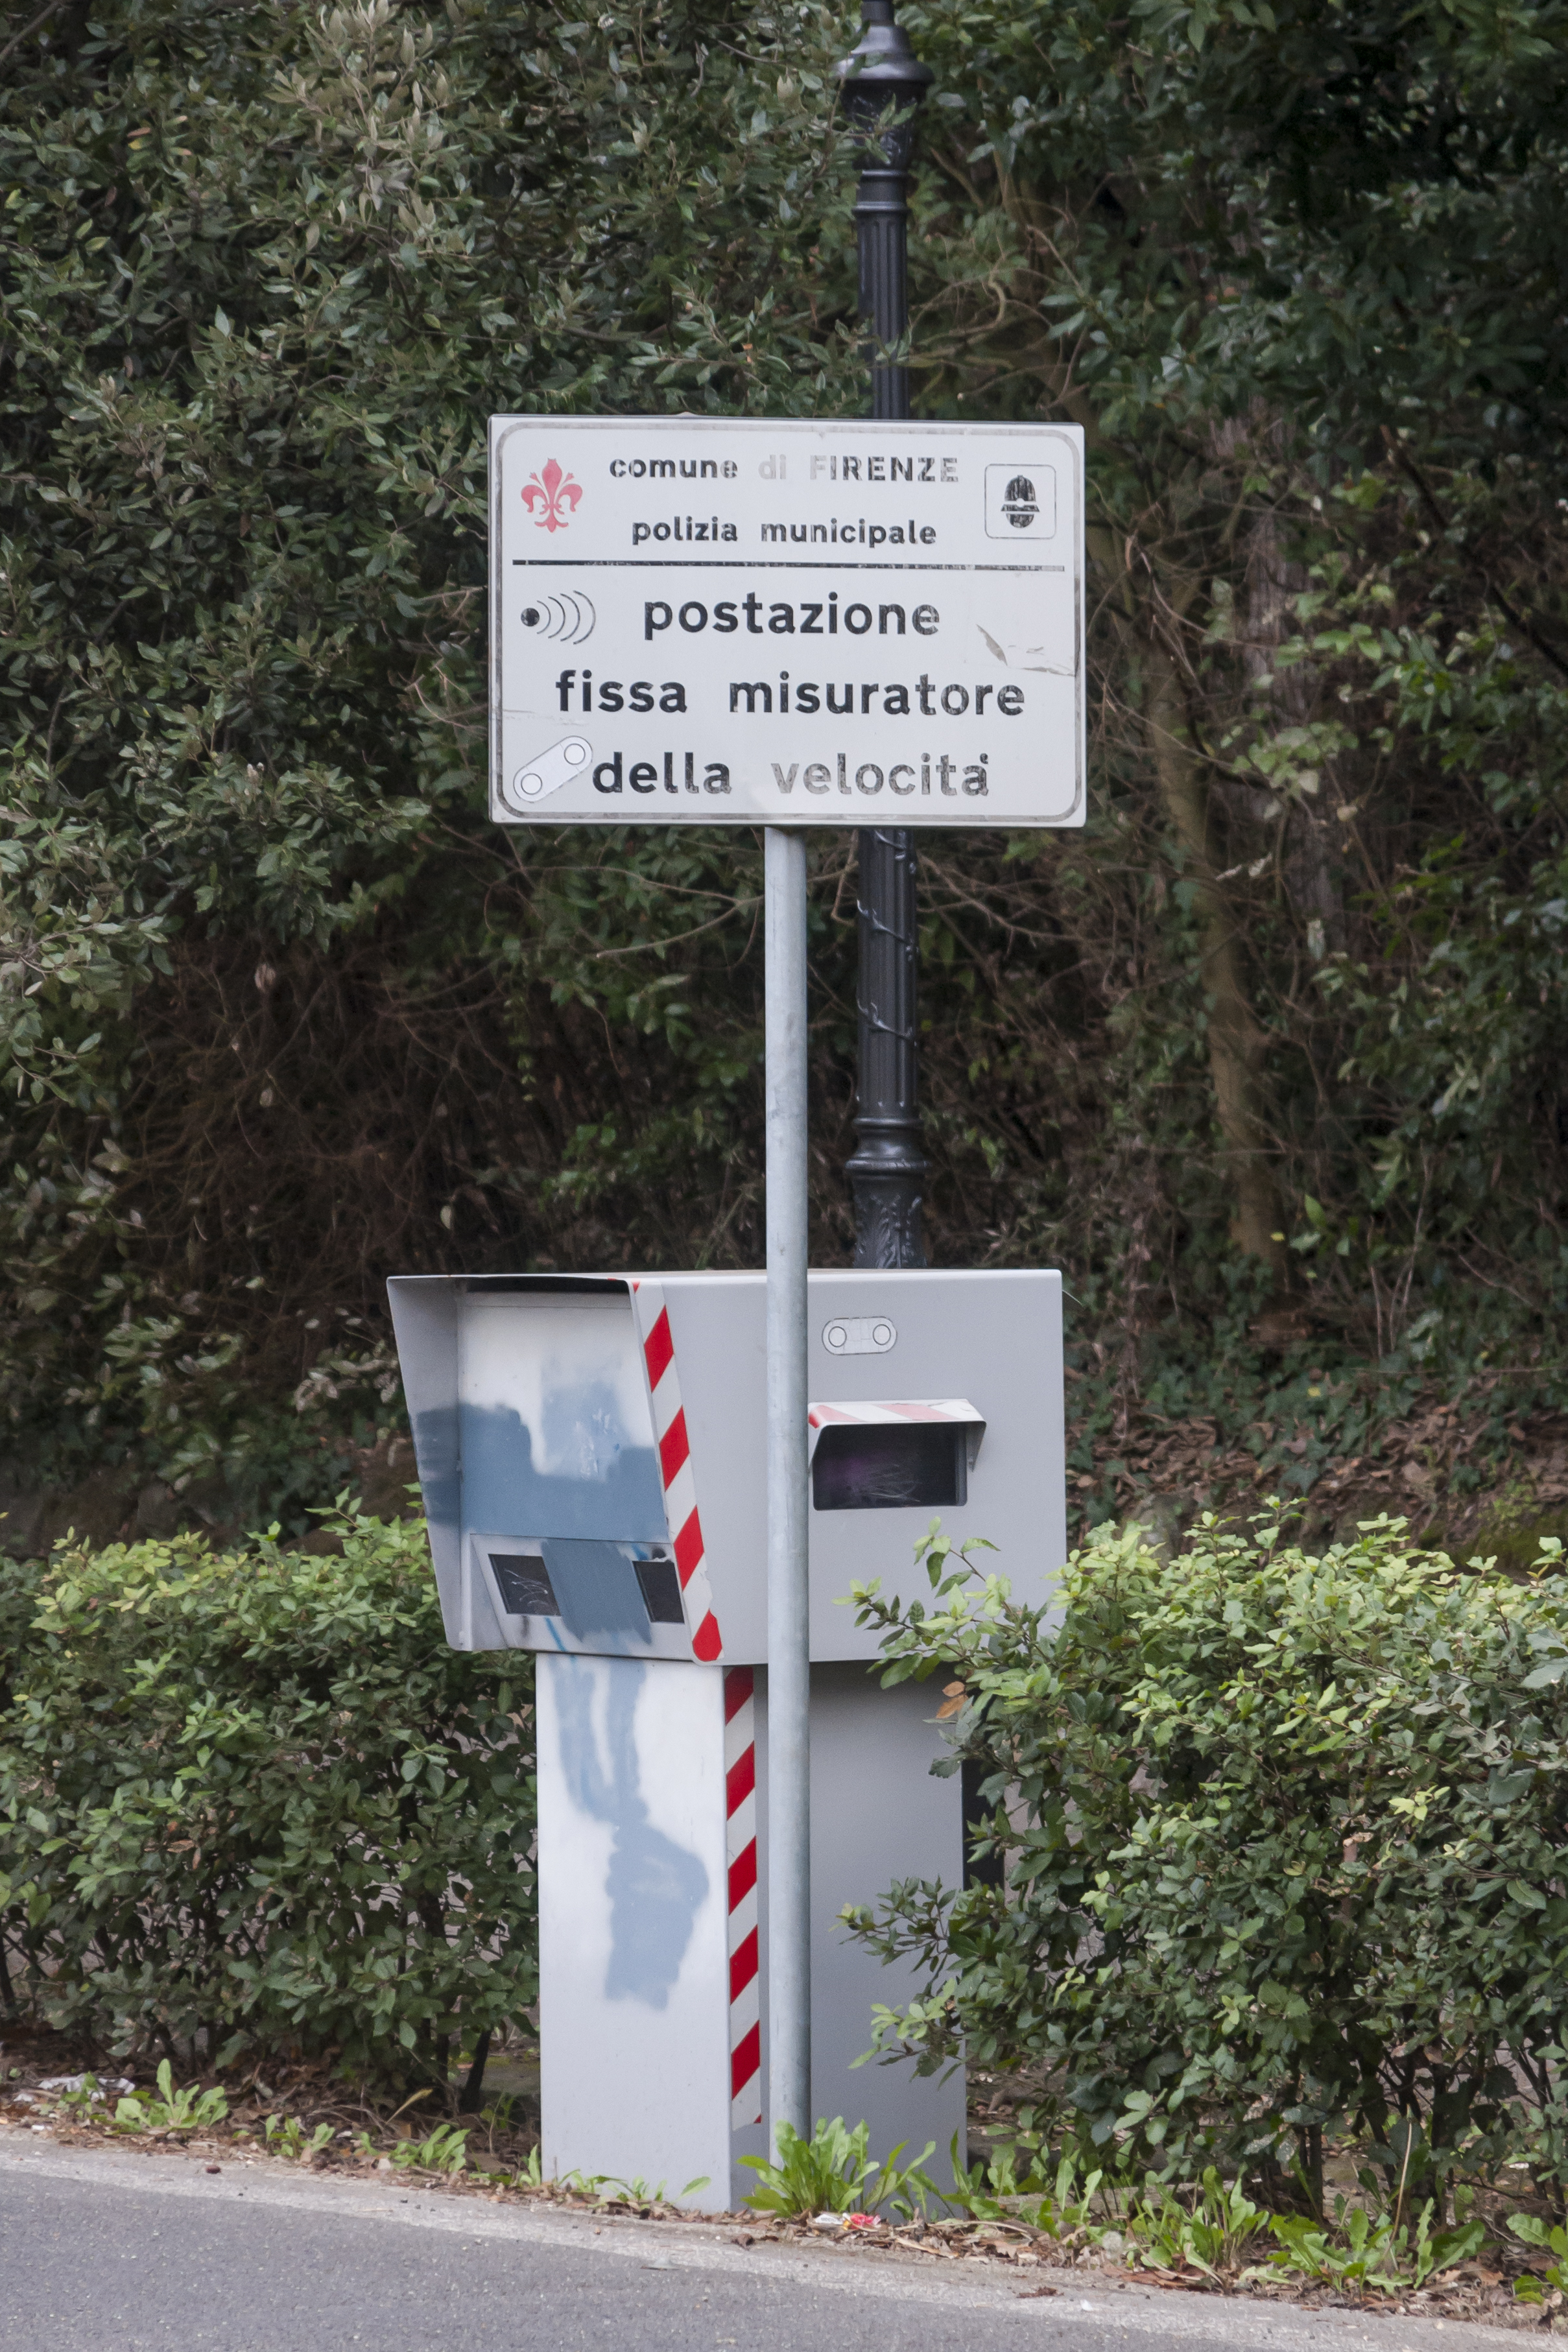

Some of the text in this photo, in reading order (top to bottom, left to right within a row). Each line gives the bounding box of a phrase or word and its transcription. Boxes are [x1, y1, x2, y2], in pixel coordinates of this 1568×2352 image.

[609, 455, 959, 482] comune di FIRENZE
[632, 516, 937, 549] polizia municipale
[645, 591, 940, 641] postazione
[555, 669, 1025, 716] fissa misuratore
[591, 751, 732, 795] della
